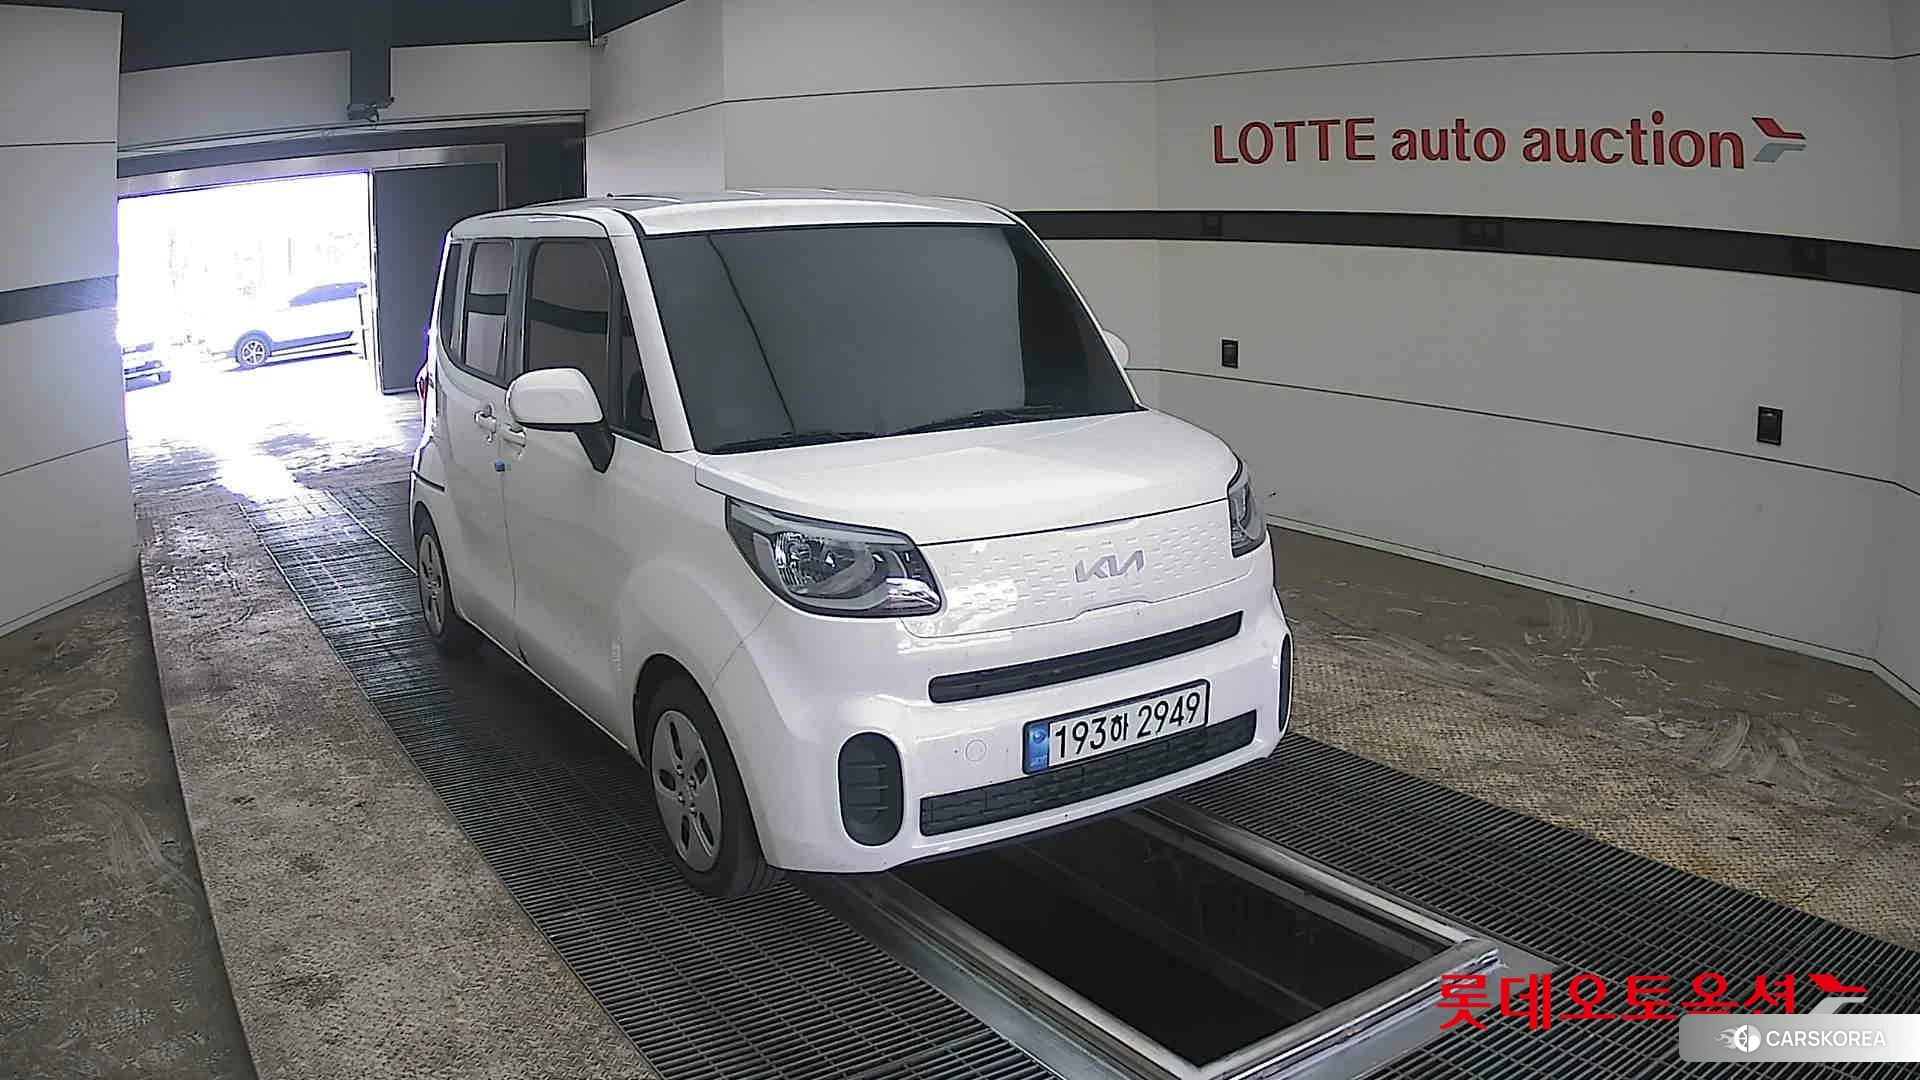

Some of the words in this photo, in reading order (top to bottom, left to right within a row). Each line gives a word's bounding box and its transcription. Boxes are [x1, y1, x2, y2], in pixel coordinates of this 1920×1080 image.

[1213, 117, 1376, 165] LOTTE
[1391, 118, 1506, 162] auto
[1522, 110, 1745, 169] auction
[1055, 712, 1129, 758] 193하
[1136, 691, 1201, 739] 2949
